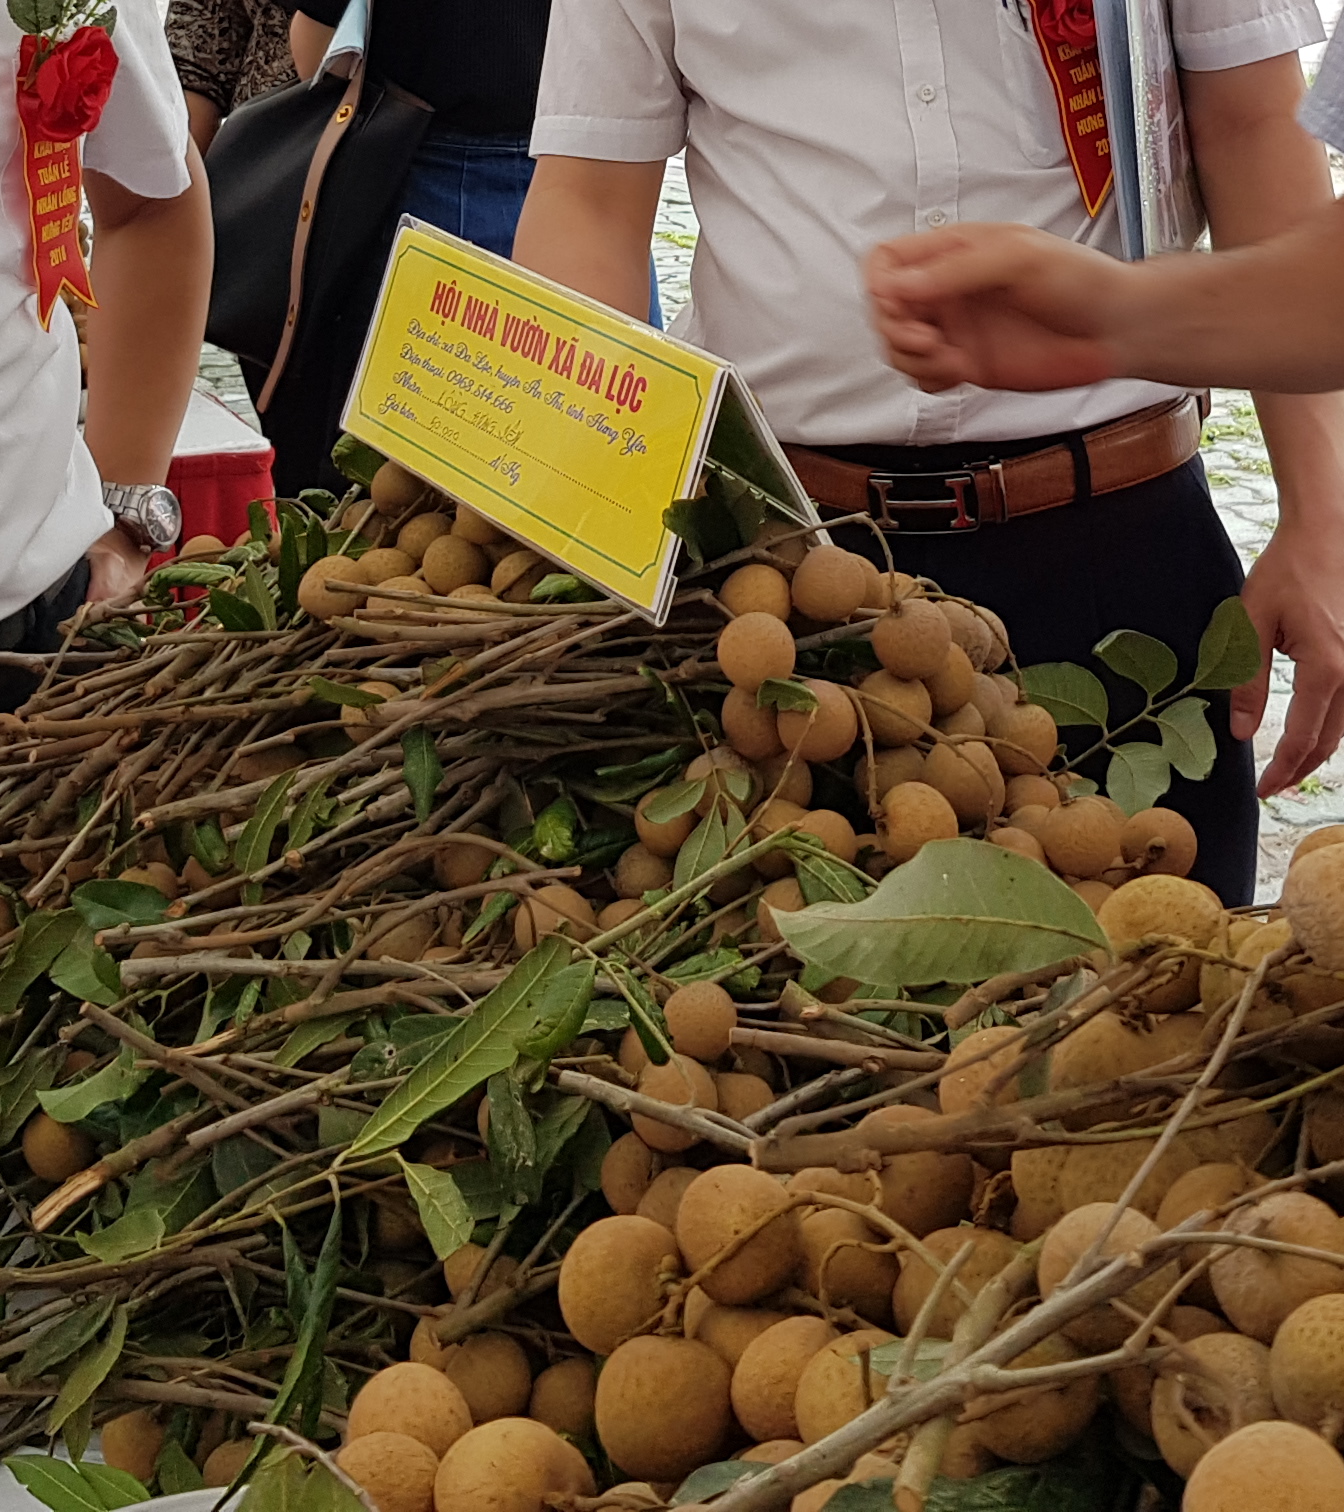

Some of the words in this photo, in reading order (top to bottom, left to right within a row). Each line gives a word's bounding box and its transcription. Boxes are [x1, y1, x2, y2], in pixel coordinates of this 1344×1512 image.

[430, 279, 463, 326] HỘI
[461, 295, 500, 342] NHÀ
[500, 313, 551, 366] VƯỜN
[547, 336, 580, 380] XÃ
[576, 350, 606, 394] ĐA
[605, 363, 648, 414] LỘC
